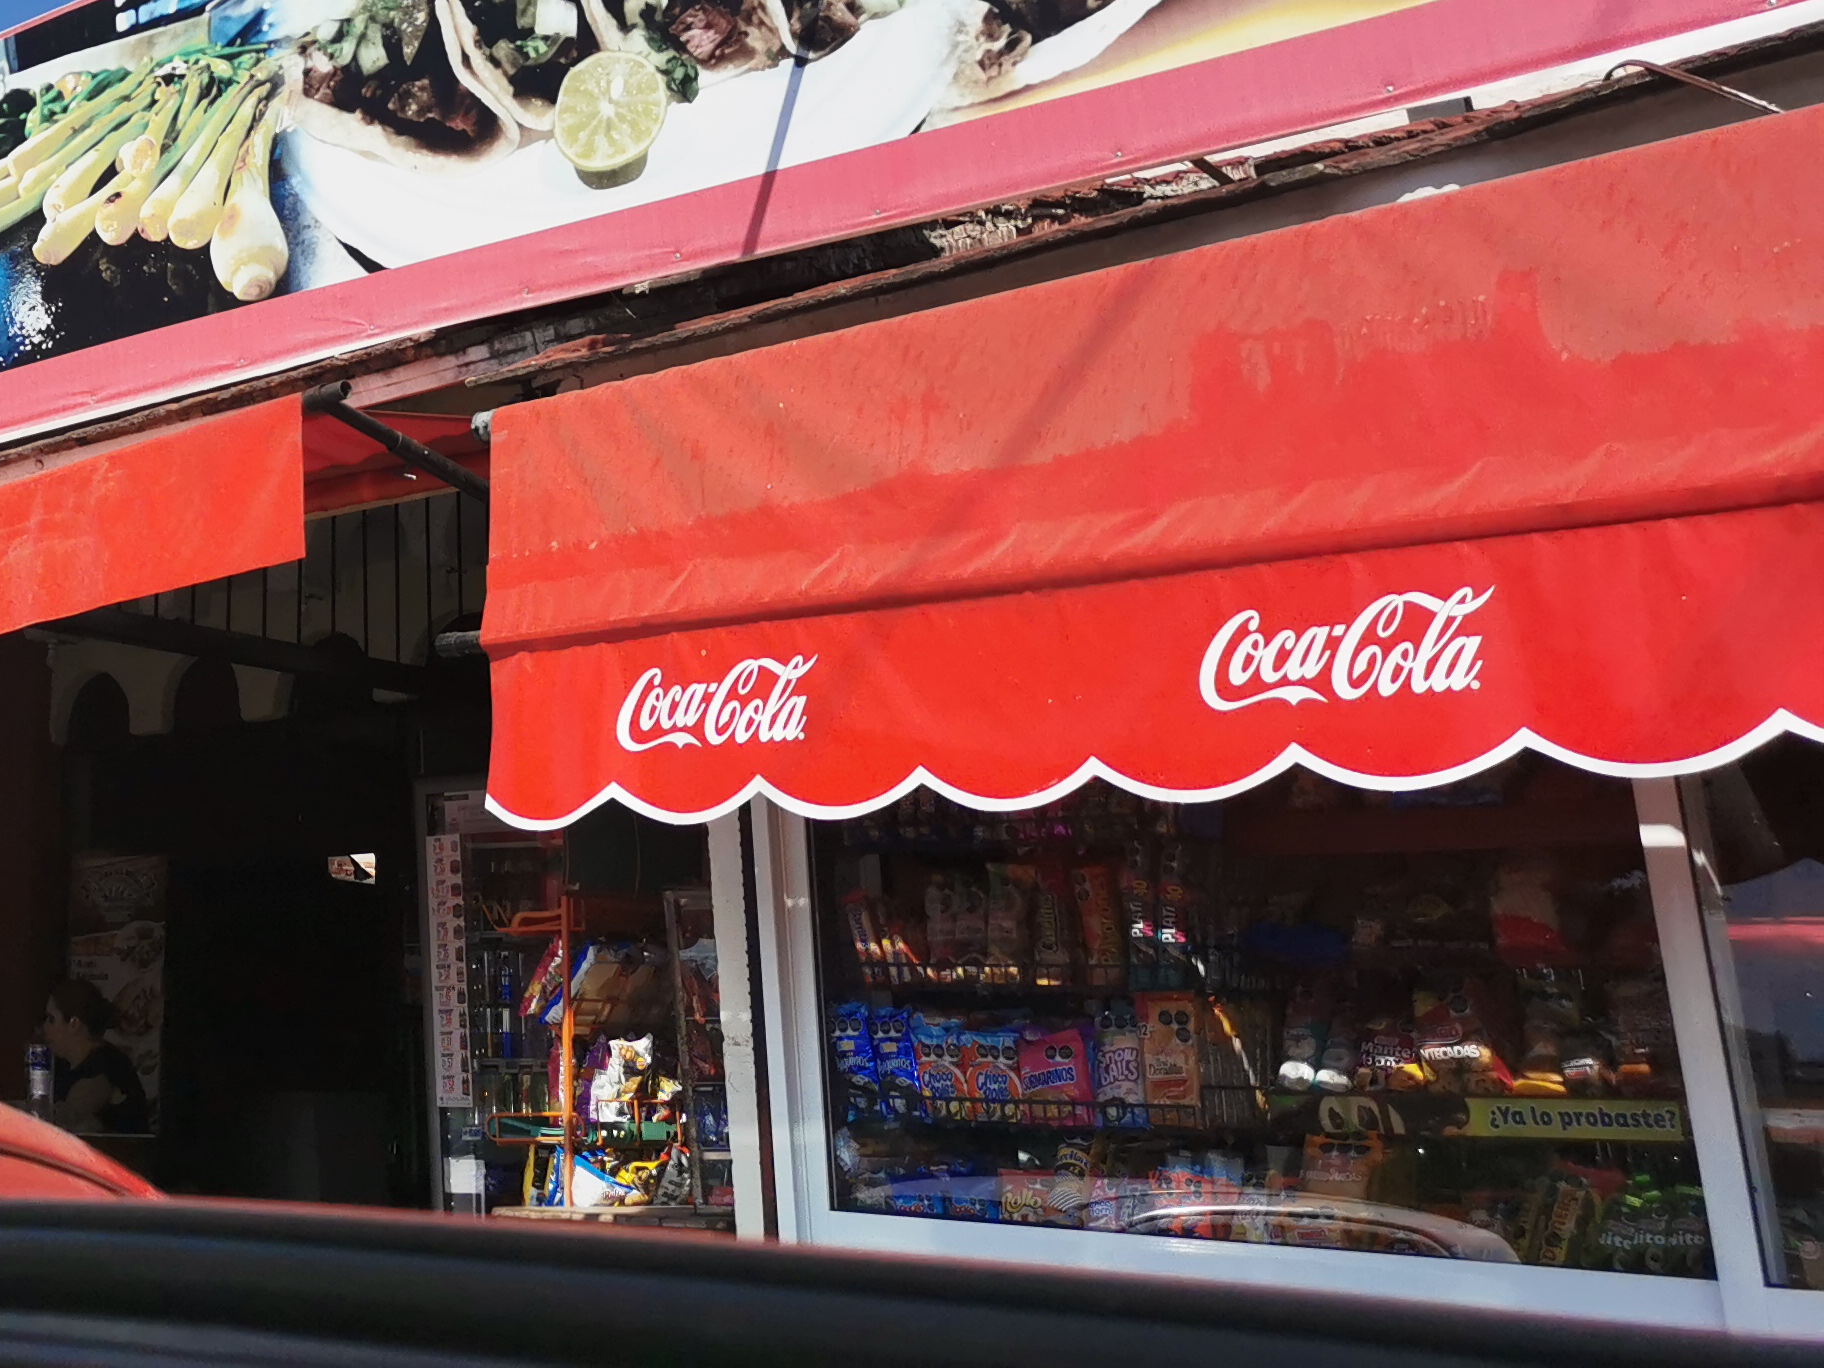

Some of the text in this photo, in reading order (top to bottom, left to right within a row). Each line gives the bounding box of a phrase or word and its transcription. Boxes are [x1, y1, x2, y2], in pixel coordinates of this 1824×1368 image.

[1198, 584, 1497, 712] Coca-Cola
[614, 653, 819, 753] Coca-Cola
[1490, 1105, 1676, 1132] ¿Ya lo probaste?
